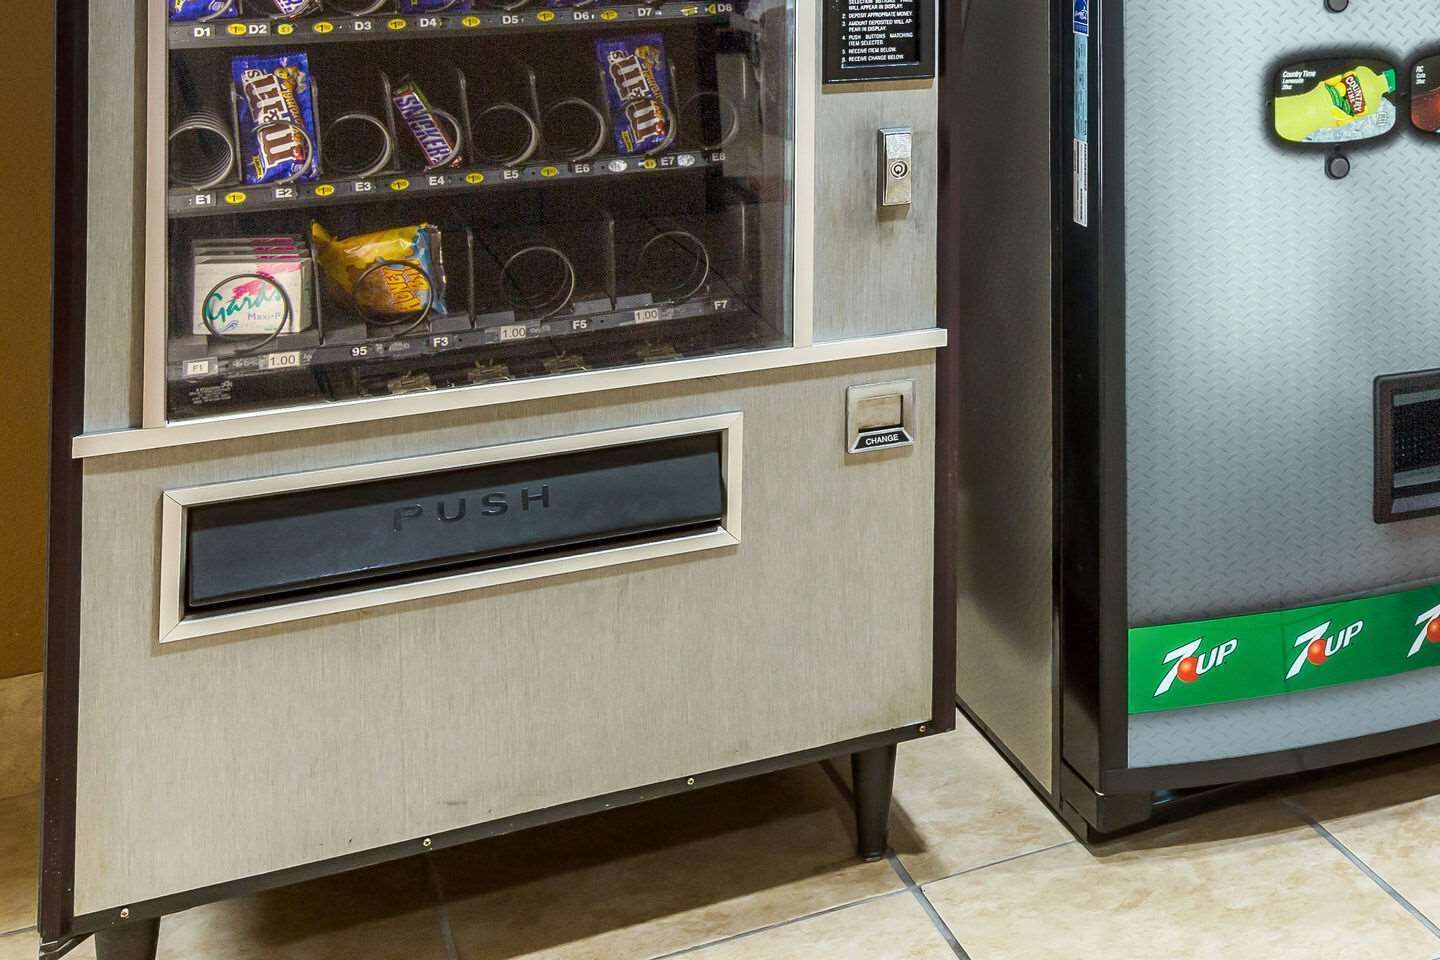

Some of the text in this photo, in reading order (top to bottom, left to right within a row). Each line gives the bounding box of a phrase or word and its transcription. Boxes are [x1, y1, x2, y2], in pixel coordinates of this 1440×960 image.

[573, 12, 590, 21] D6
[637, 7, 653, 17] D7
[420, 18, 437, 28] D4
[502, 15, 519, 25] D5
[249, 24, 267, 35] D2
[355, 22, 372, 31] D3
[194, 27, 212, 38] D1
[1302, 70, 1316, 78] Time
[1345, 76, 1363, 113] COUNTRY
[660, 157, 675, 167] E7
[503, 170, 519, 180] E5
[575, 165, 590, 174] E6
[355, 182, 372, 191] E3
[429, 177, 445, 186] E4
[275, 188, 292, 198] E2
[195, 195, 212, 205] E1
[714, 300, 729, 311] F7
[635, 309, 659, 321] 1.00
[573, 319, 588, 330] F5
[502, 326, 526, 338] 1.00
[433, 336, 450, 348] F3
[352, 346, 368, 357] 95
[270, 353, 296, 366] 1.00
[865, 433, 899, 446] CHANGE
[392, 484, 550, 533] PUSH
[1285, 619, 1364, 680] 7UP
[1153, 638, 1238, 698] 7UP
